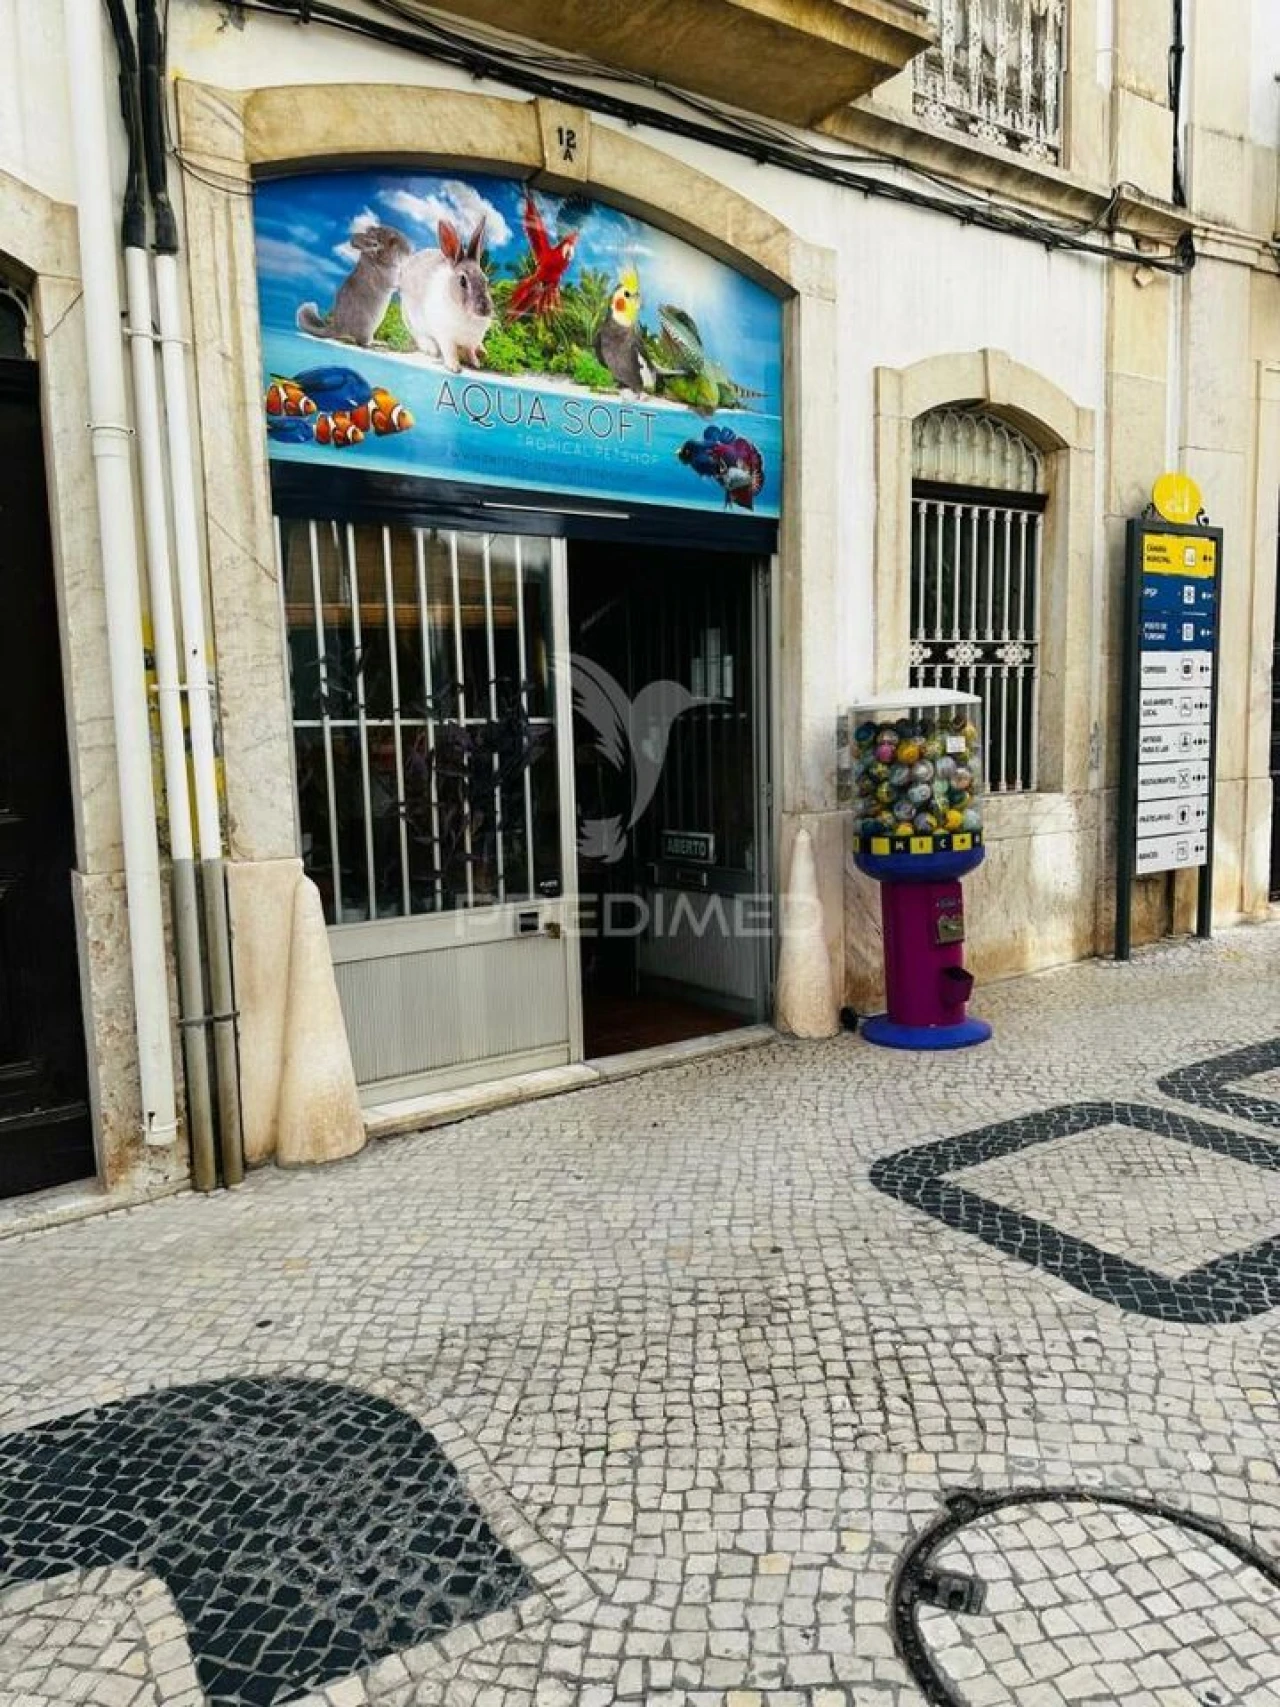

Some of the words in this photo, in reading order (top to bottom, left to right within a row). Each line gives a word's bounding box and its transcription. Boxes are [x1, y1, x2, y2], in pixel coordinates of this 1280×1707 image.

[557, 126, 577, 149] 12
[563, 148, 573, 162] A
[436, 379, 549, 428] AQUA
[562, 400, 658, 444] SOFT
